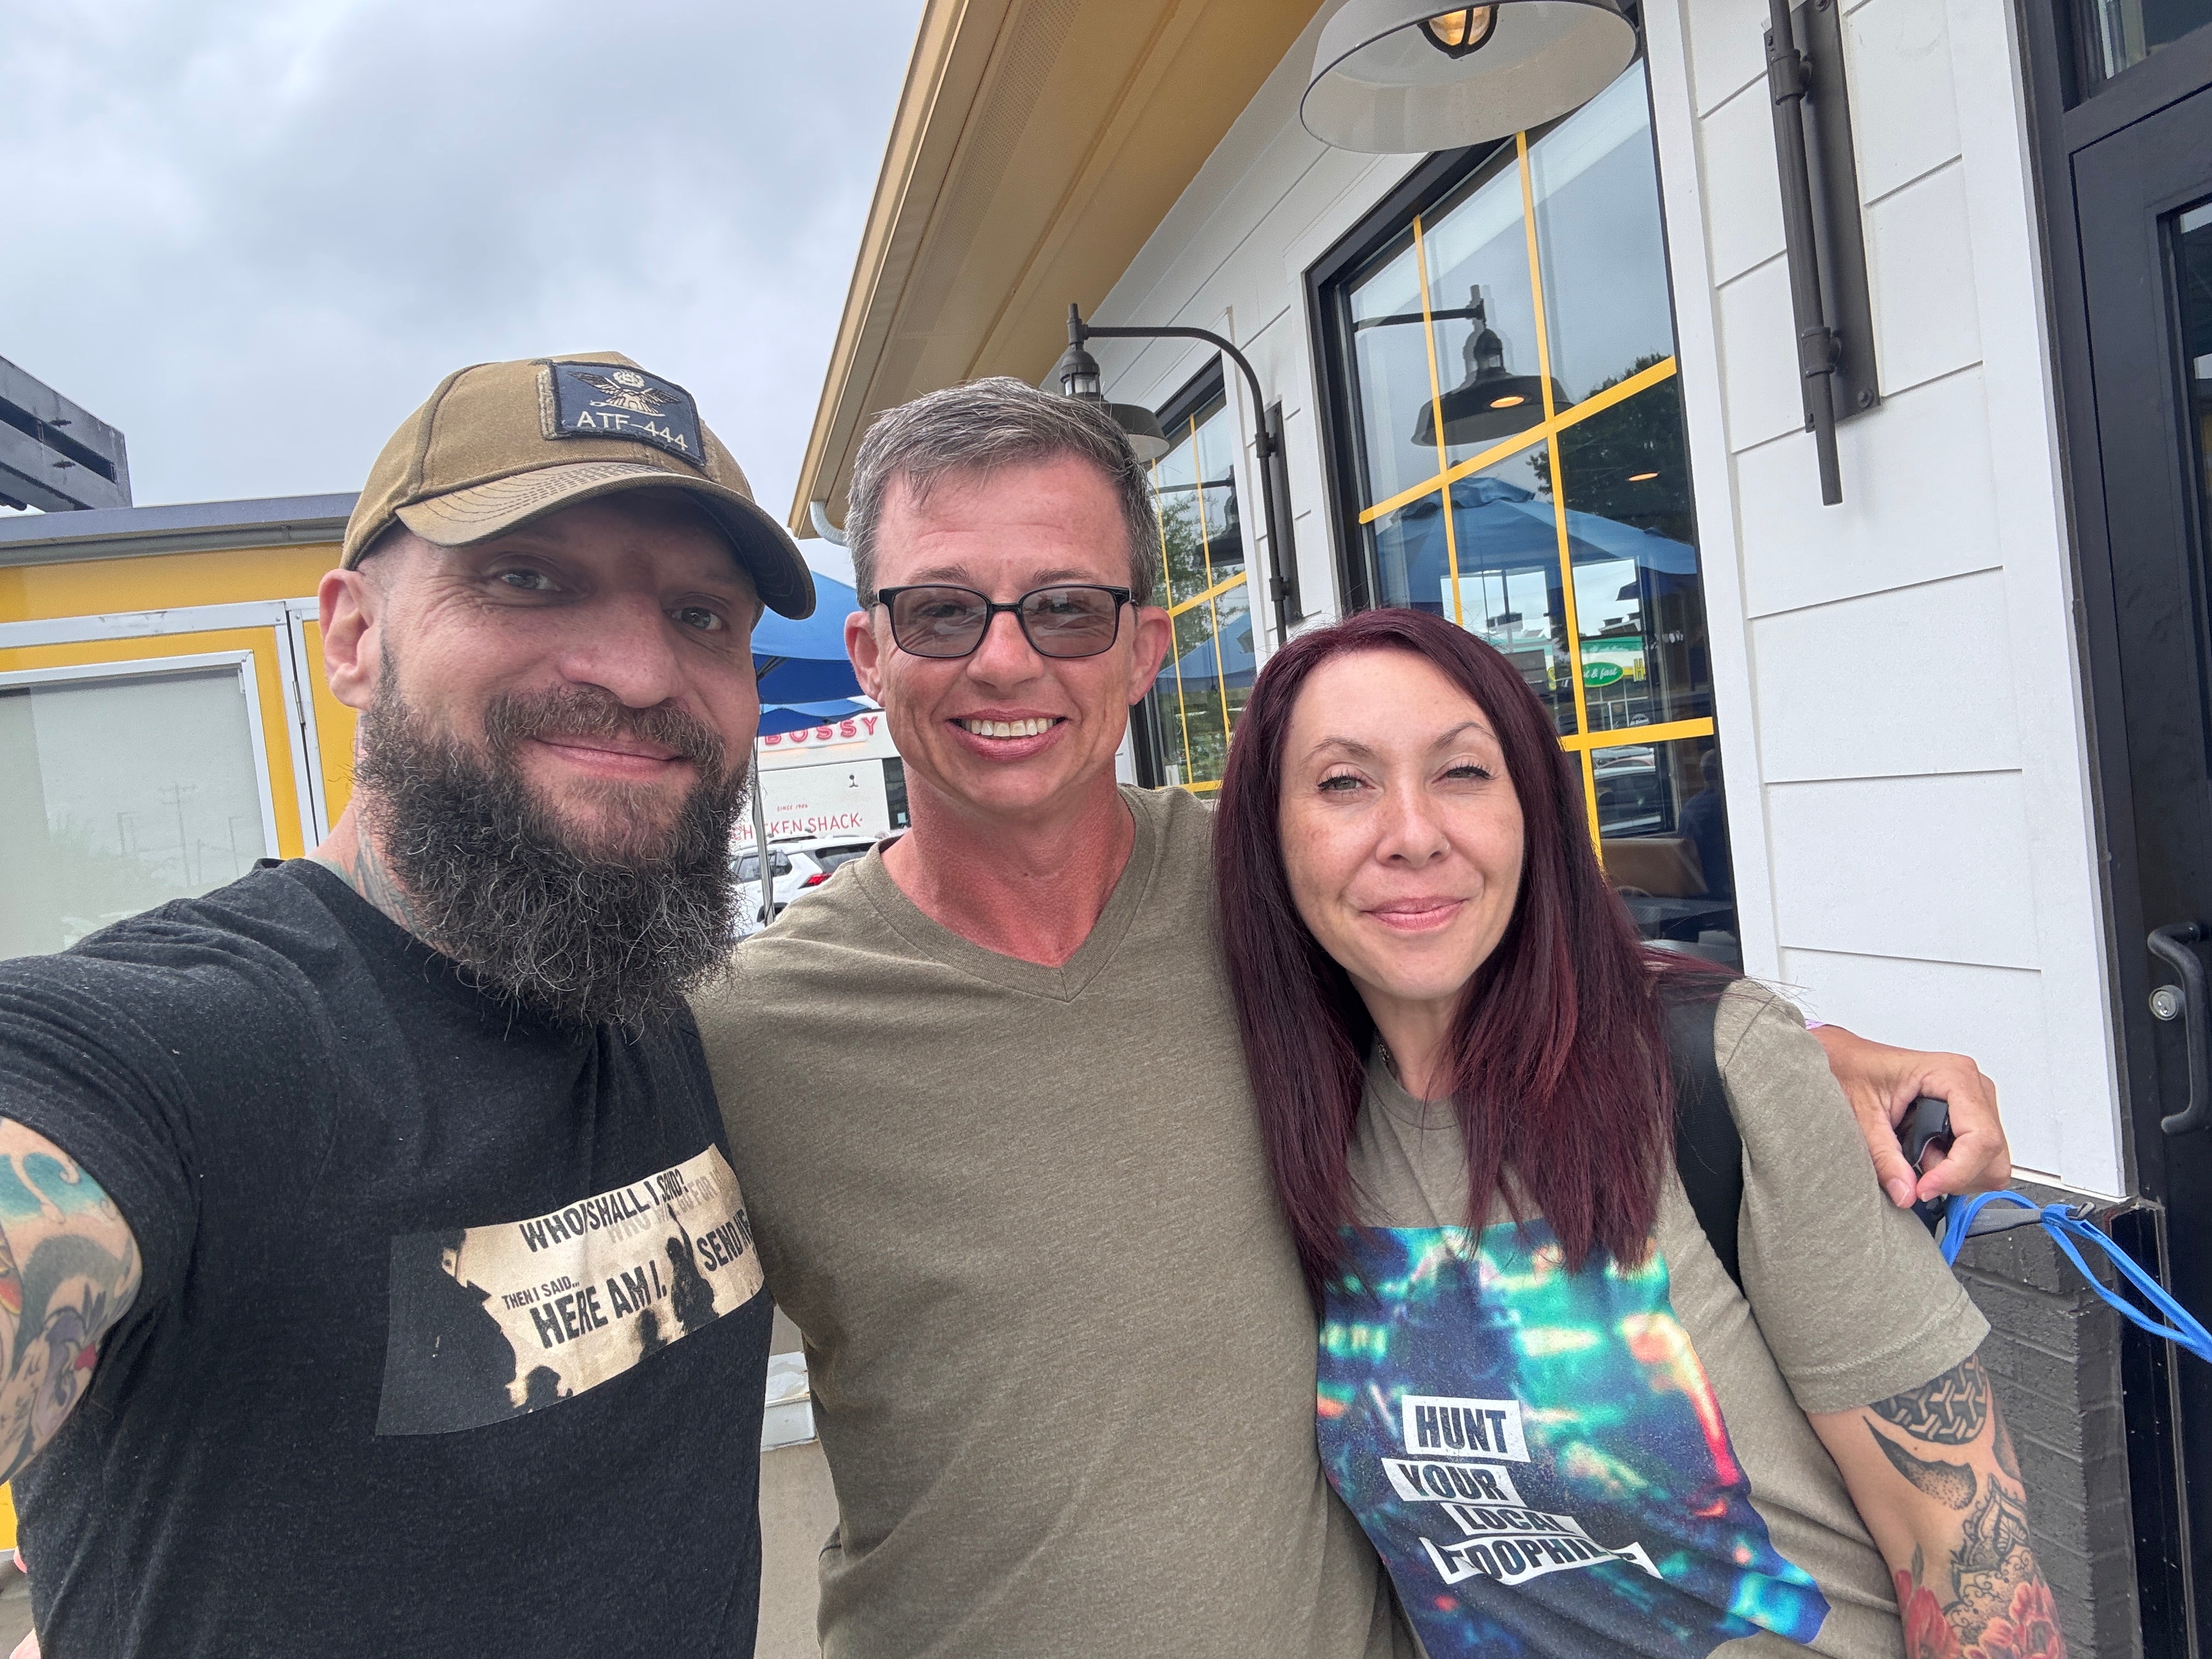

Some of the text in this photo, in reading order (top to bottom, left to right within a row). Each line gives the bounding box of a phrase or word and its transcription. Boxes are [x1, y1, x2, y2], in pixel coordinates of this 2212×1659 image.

[764, 716, 878, 746] BOSSY
[586, 1188, 651, 1230] SHALL
[644, 1181, 659, 1205] I
[696, 1221, 743, 1271] SEND
[501, 1289, 534, 1310] THEN
[532, 1286, 540, 1301] I
[529, 1285, 609, 1349] HERE
[606, 1266, 652, 1318] AM
[1415, 1405, 1508, 1454] HUNT
[1397, 1464, 1509, 1501] YOUR
[1452, 1504, 1577, 1535] LOCAL
